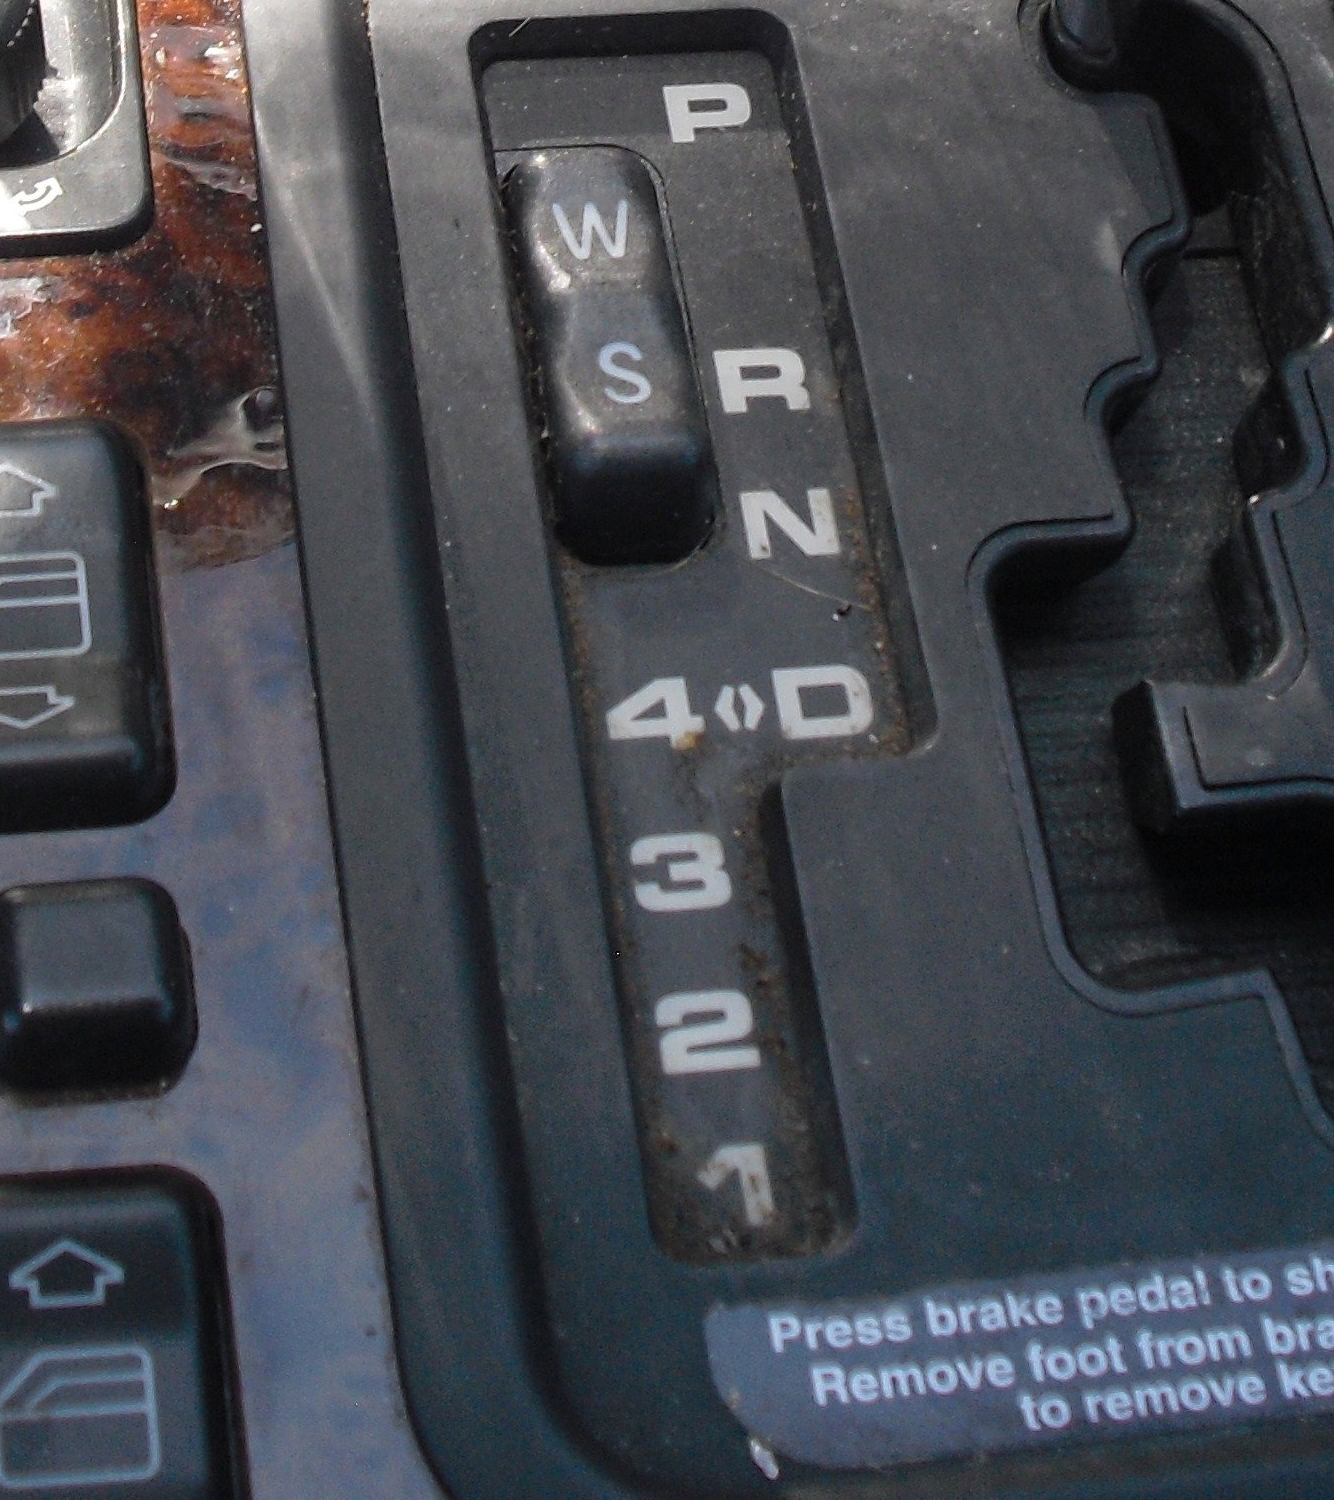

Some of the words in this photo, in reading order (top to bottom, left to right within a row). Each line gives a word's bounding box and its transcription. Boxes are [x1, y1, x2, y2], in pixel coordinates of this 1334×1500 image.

[662, 82, 753, 144] P
[551, 200, 628, 259] W
[597, 341, 652, 404] S
[712, 347, 811, 414] R
[739, 487, 841, 560] N
[771, 664, 875, 740] D
[629, 831, 733, 912] 3
[654, 988, 762, 1076] 2
[697, 1141, 775, 1228] 1
[768, 1308, 913, 1353] Press
[923, 1290, 1065, 1337] brake
[1075, 1267, 1212, 1329] pedal
[1220, 1267, 1272, 1303] to
[810, 1355, 1016, 1406] Remove
[1026, 1336, 1127, 1383] foot
[1136, 1327, 1253, 1370] from
[1020, 1393, 1072, 1431] to
[1082, 1372, 1267, 1424] remove
